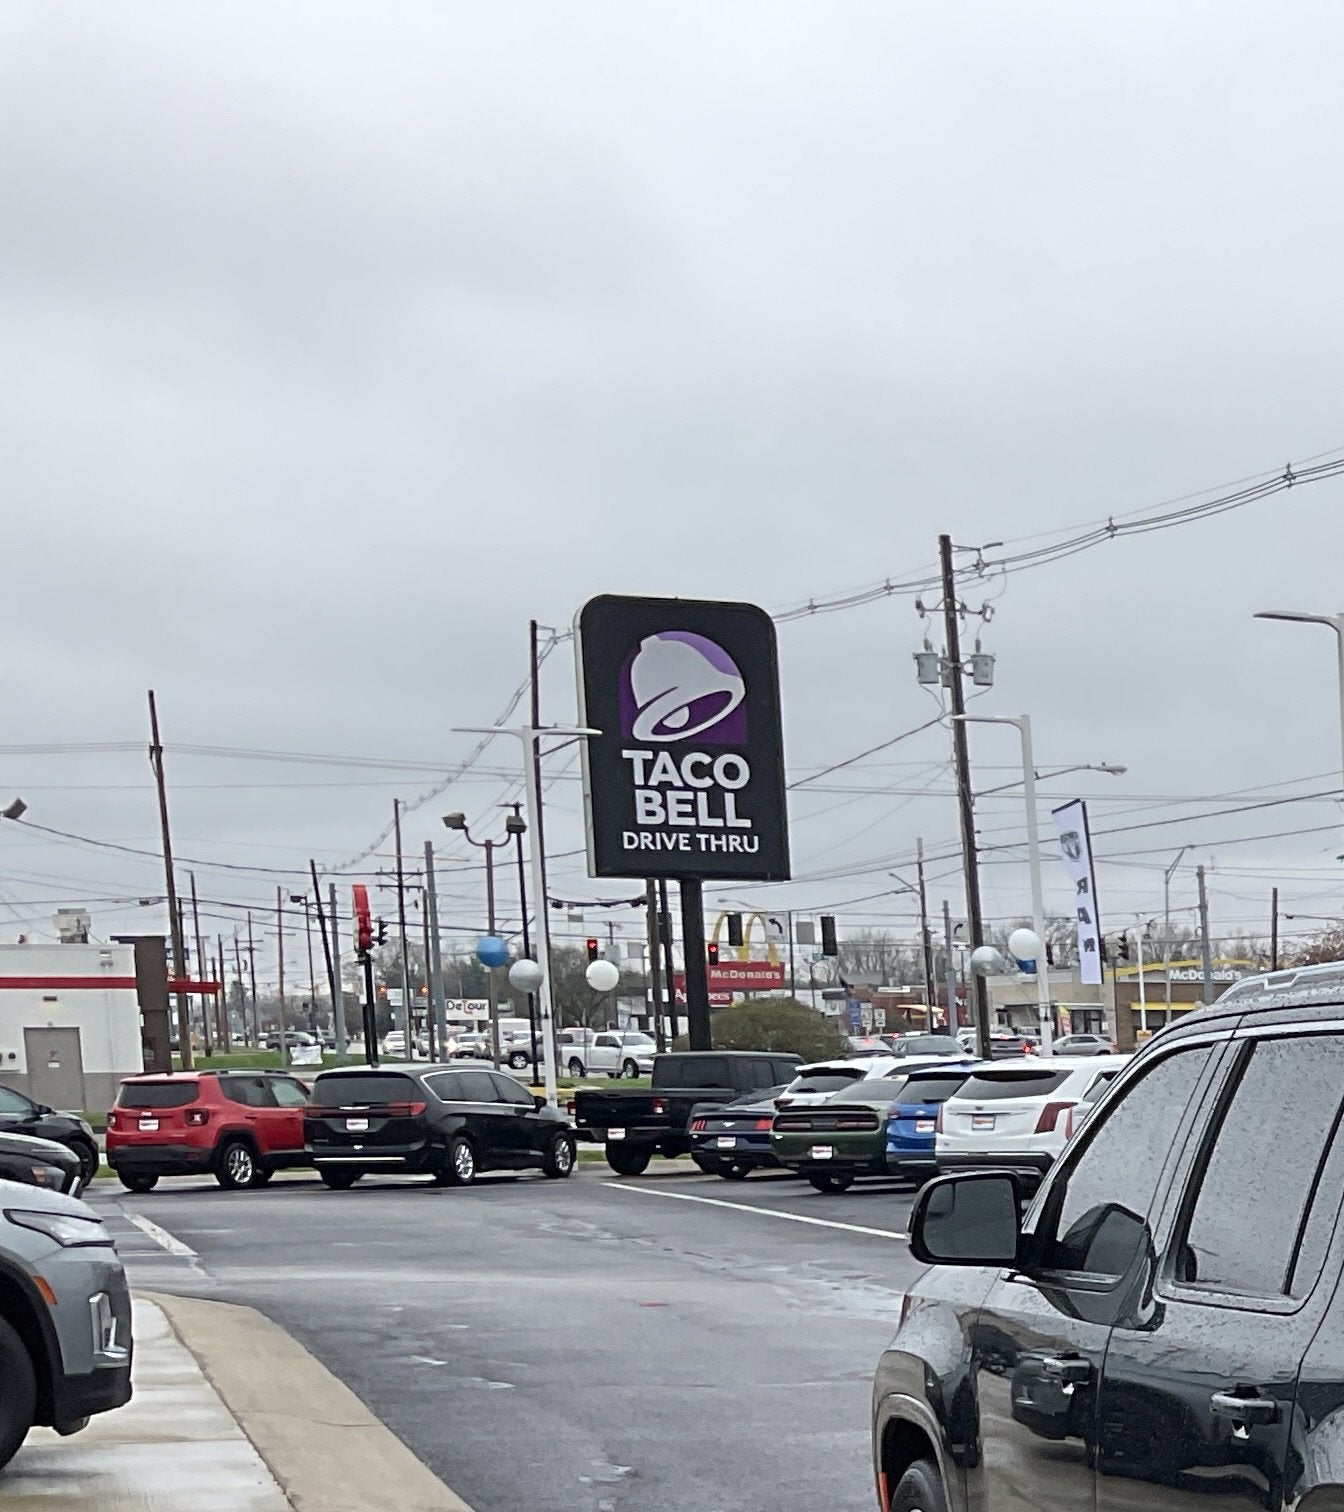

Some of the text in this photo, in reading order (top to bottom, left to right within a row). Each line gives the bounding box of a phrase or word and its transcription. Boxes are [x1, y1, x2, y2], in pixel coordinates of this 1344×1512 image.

[621, 749, 751, 790] TACO
[635, 789, 752, 828] BELL
[622, 831, 760, 853] DRIVE THRU
[710, 969, 781, 980] McDonald's
